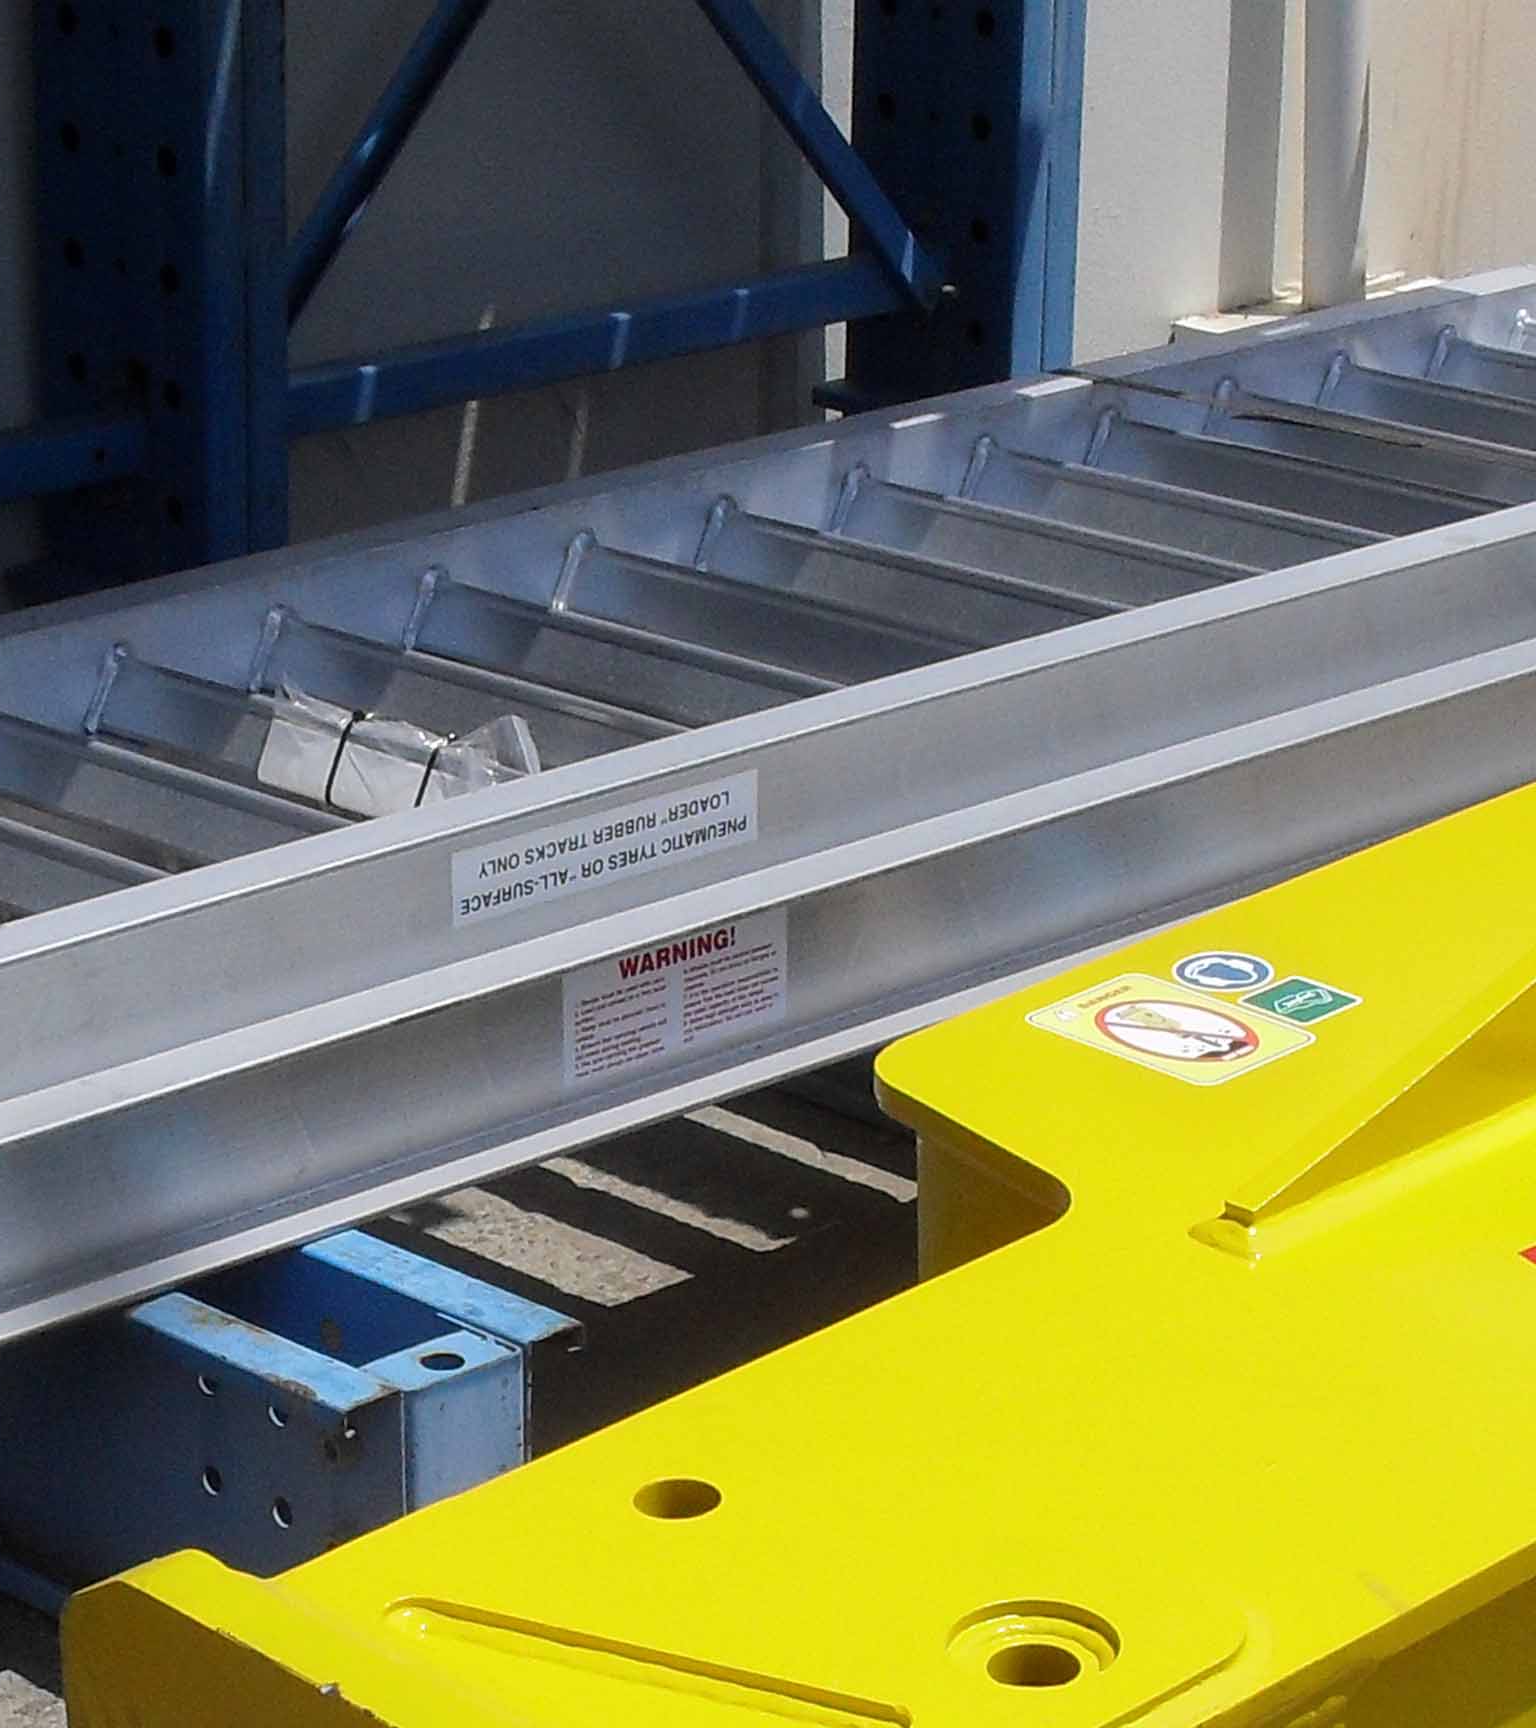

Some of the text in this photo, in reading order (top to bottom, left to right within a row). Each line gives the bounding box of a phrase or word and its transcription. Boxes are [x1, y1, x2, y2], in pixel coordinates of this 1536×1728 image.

[592, 811, 657, 844] RUBBER
[662, 815, 748, 856] PNEUMATIC
[478, 853, 521, 879] ONLY
[524, 835, 589, 867] TRACKS
[607, 844, 657, 871] TYRES
[580, 860, 604, 880] OR
[617, 925, 737, 981] WARNING!
